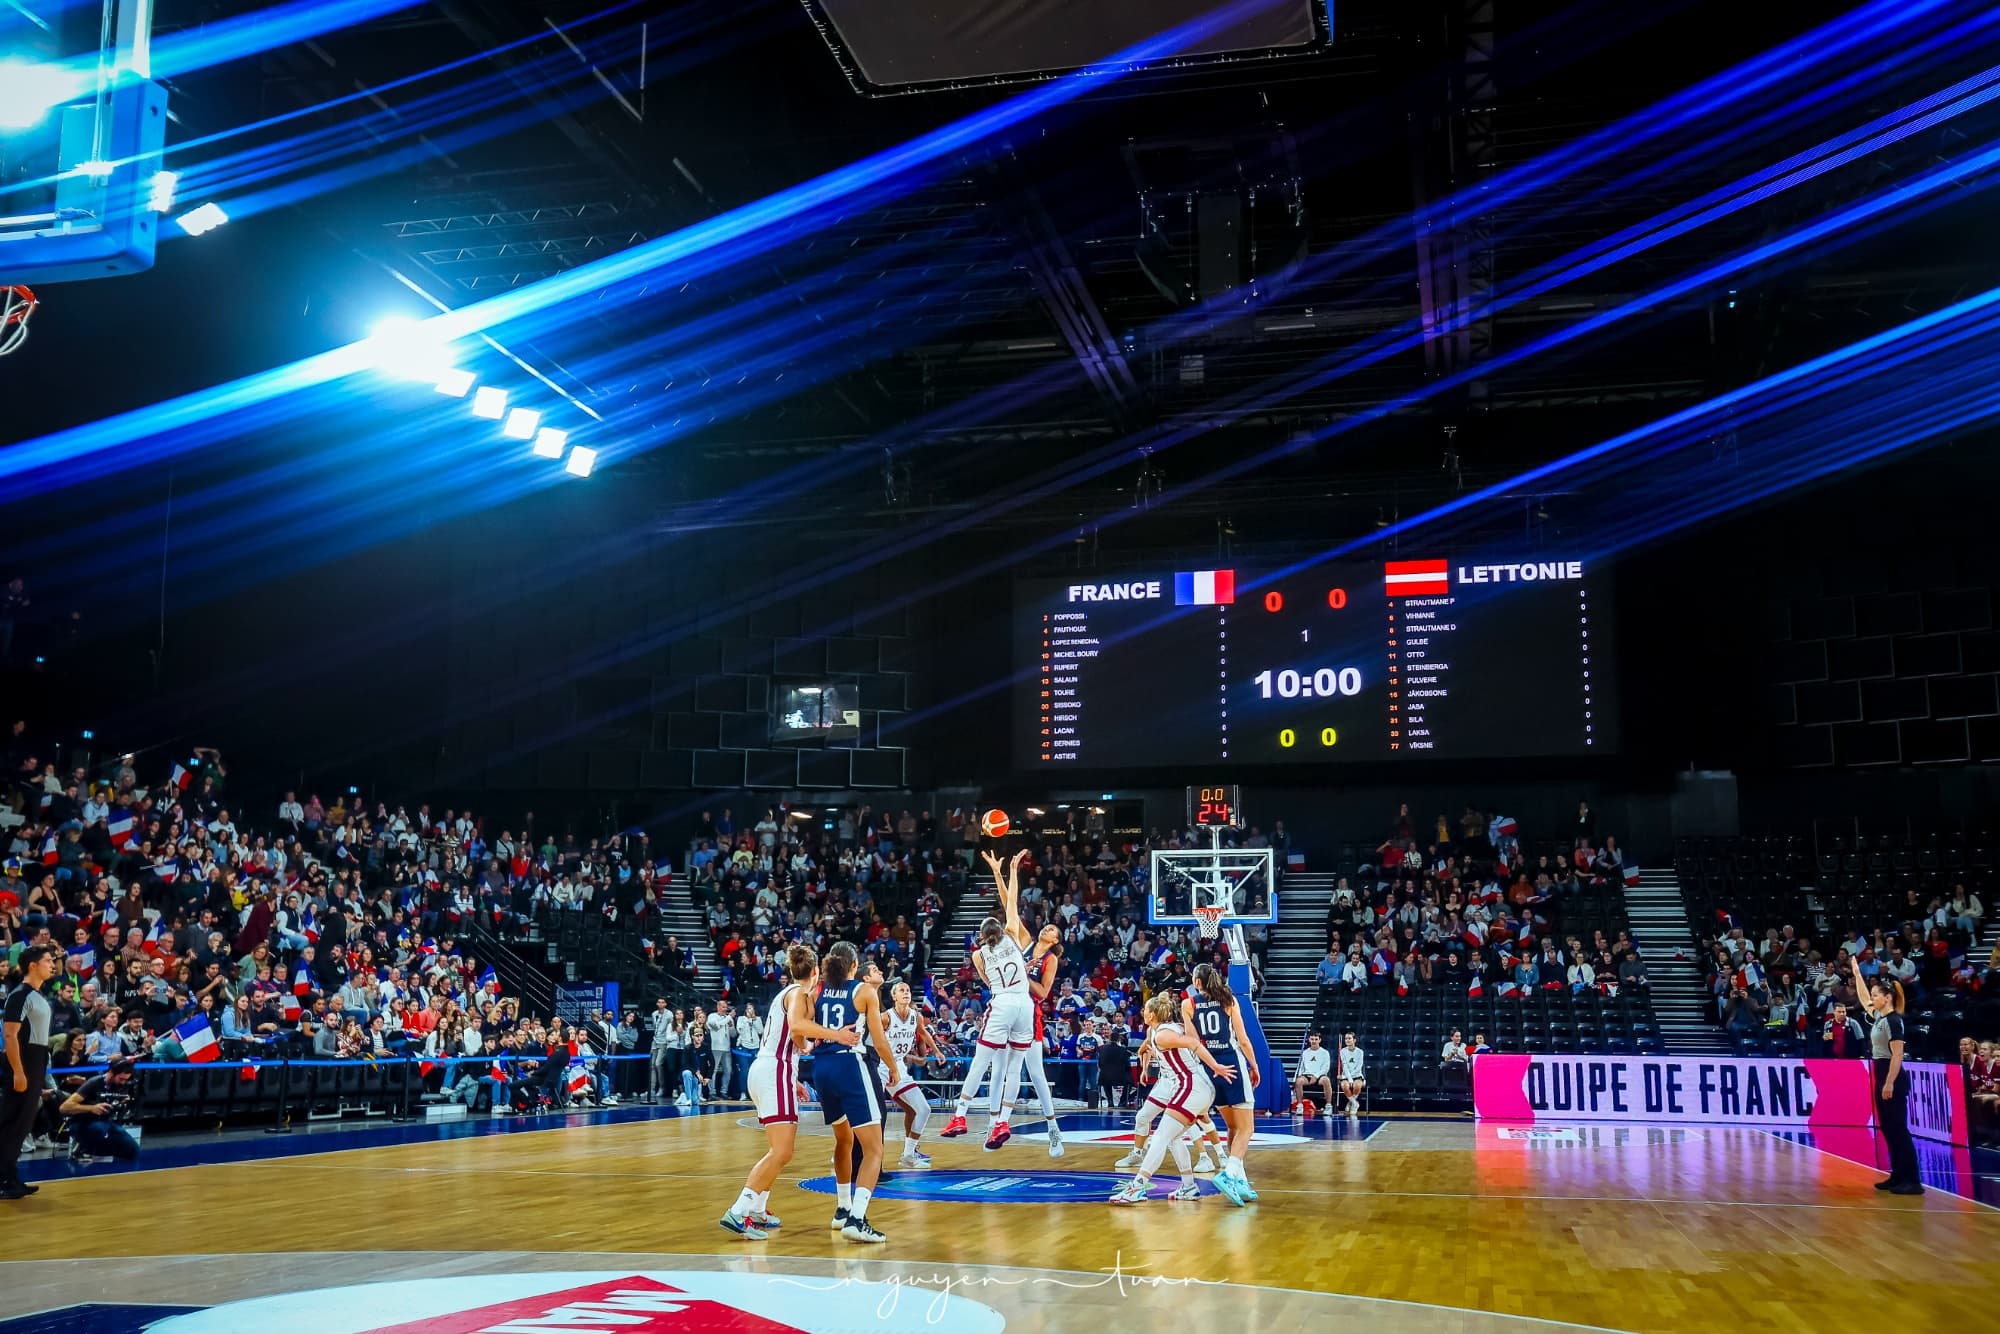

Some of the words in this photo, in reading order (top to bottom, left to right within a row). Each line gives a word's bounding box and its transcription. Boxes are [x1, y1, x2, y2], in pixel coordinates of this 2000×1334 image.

[1458, 561, 1583, 583] LETTONIE
[1068, 581, 1161, 603] FRANCE
[1265, 592, 1283, 613] 0
[1327, 588, 1346, 610] 0
[1301, 629, 1309, 643] 1
[1388, 639, 1397, 647] 10
[1388, 652, 1397, 660] 11
[1405, 650, 1426, 658] OTTO
[1254, 667, 1363, 699] 10:00
[1279, 728, 1295, 748] 0
[1321, 727, 1337, 747] 0
[1201, 788, 1223, 802] 0.0
[1197, 803, 1229, 823] 24
[995, 962, 1021, 989] 12
[823, 988, 848, 999] SALAUN
[821, 1003, 846, 1032] 13
[1198, 1010, 1220, 1036] 10
[896, 1043, 909, 1054] 33
[1644, 1063, 1684, 1114] DE
